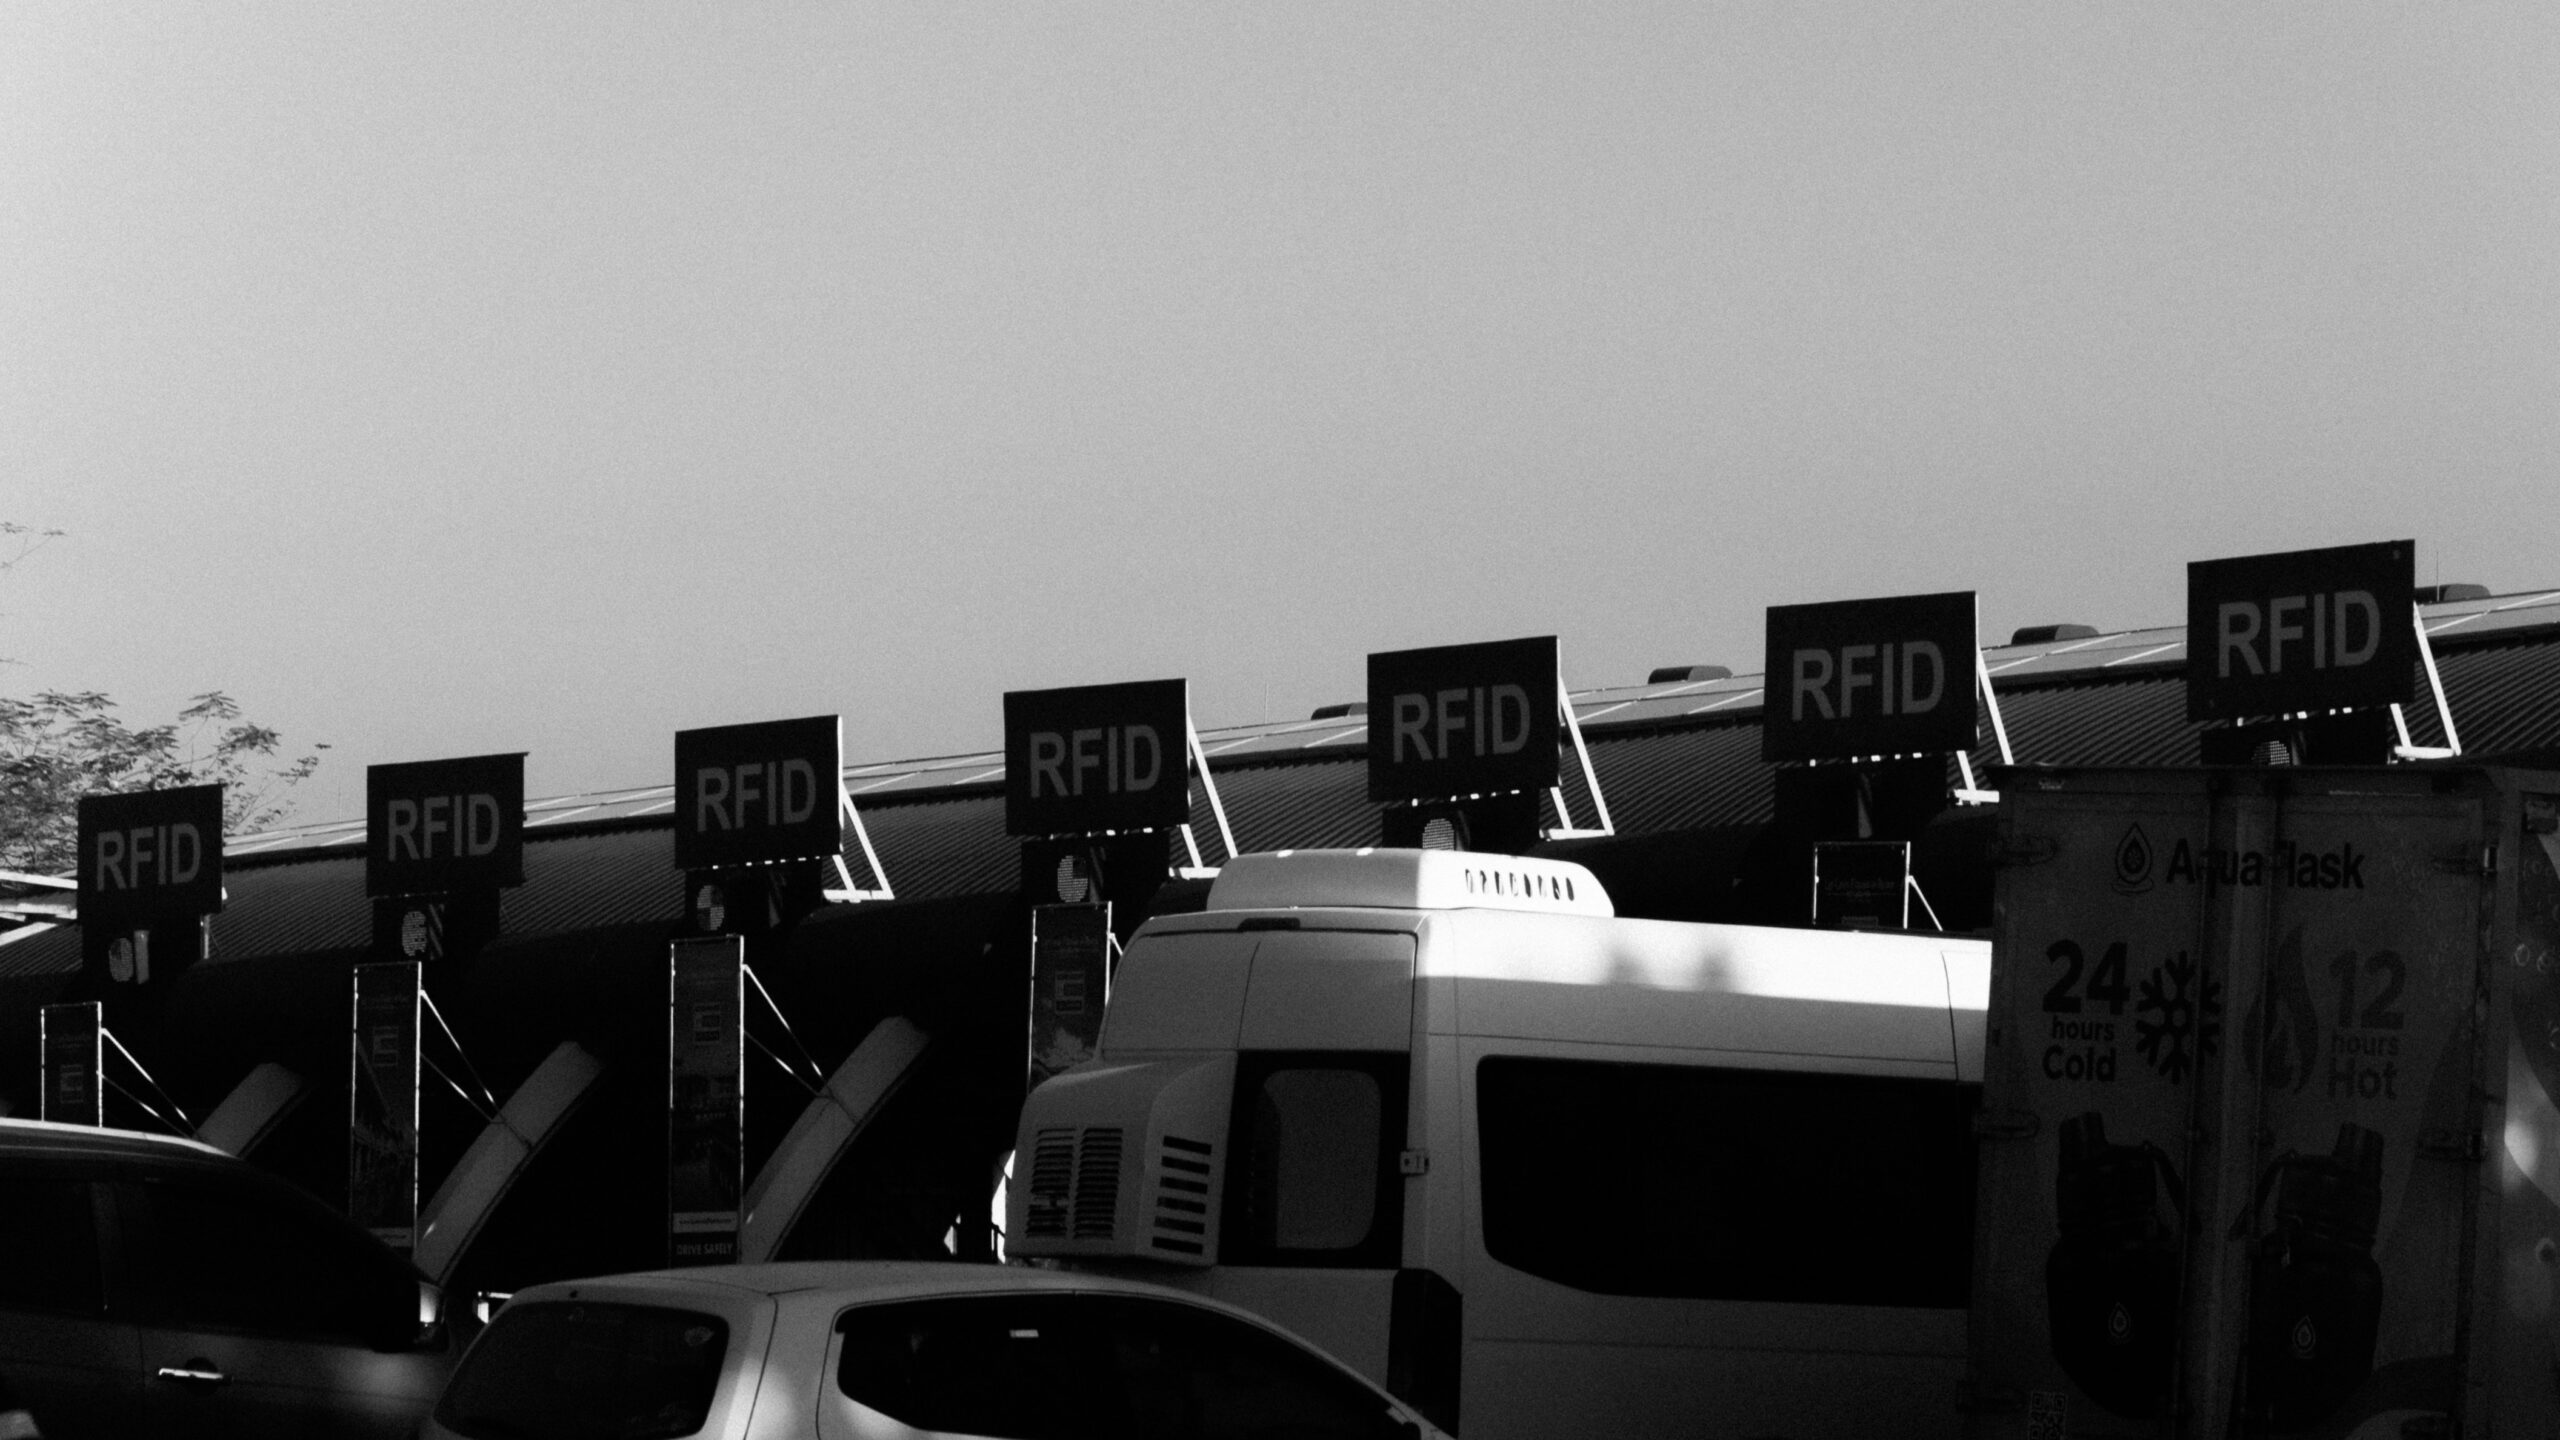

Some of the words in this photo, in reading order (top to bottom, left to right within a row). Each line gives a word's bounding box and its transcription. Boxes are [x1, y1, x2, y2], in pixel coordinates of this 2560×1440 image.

[2218, 590, 2381, 678] RFID
[1792, 640, 1944, 720] RFID
[1393, 684, 1530, 763] RFID
[697, 758, 816, 832] RFID
[1030, 725, 1162, 798] RFID
[96, 823, 201, 891] RFID
[388, 793, 500, 861] RFID
[2043, 939, 2130, 1016] 24
[2329, 950, 2405, 1029] 12
[2043, 1046, 2115, 1082] Cold
[2052, 1015, 2115, 1041] hours
[2331, 1033, 2399, 1057] hours
[2328, 1058, 2398, 1099] Hot
